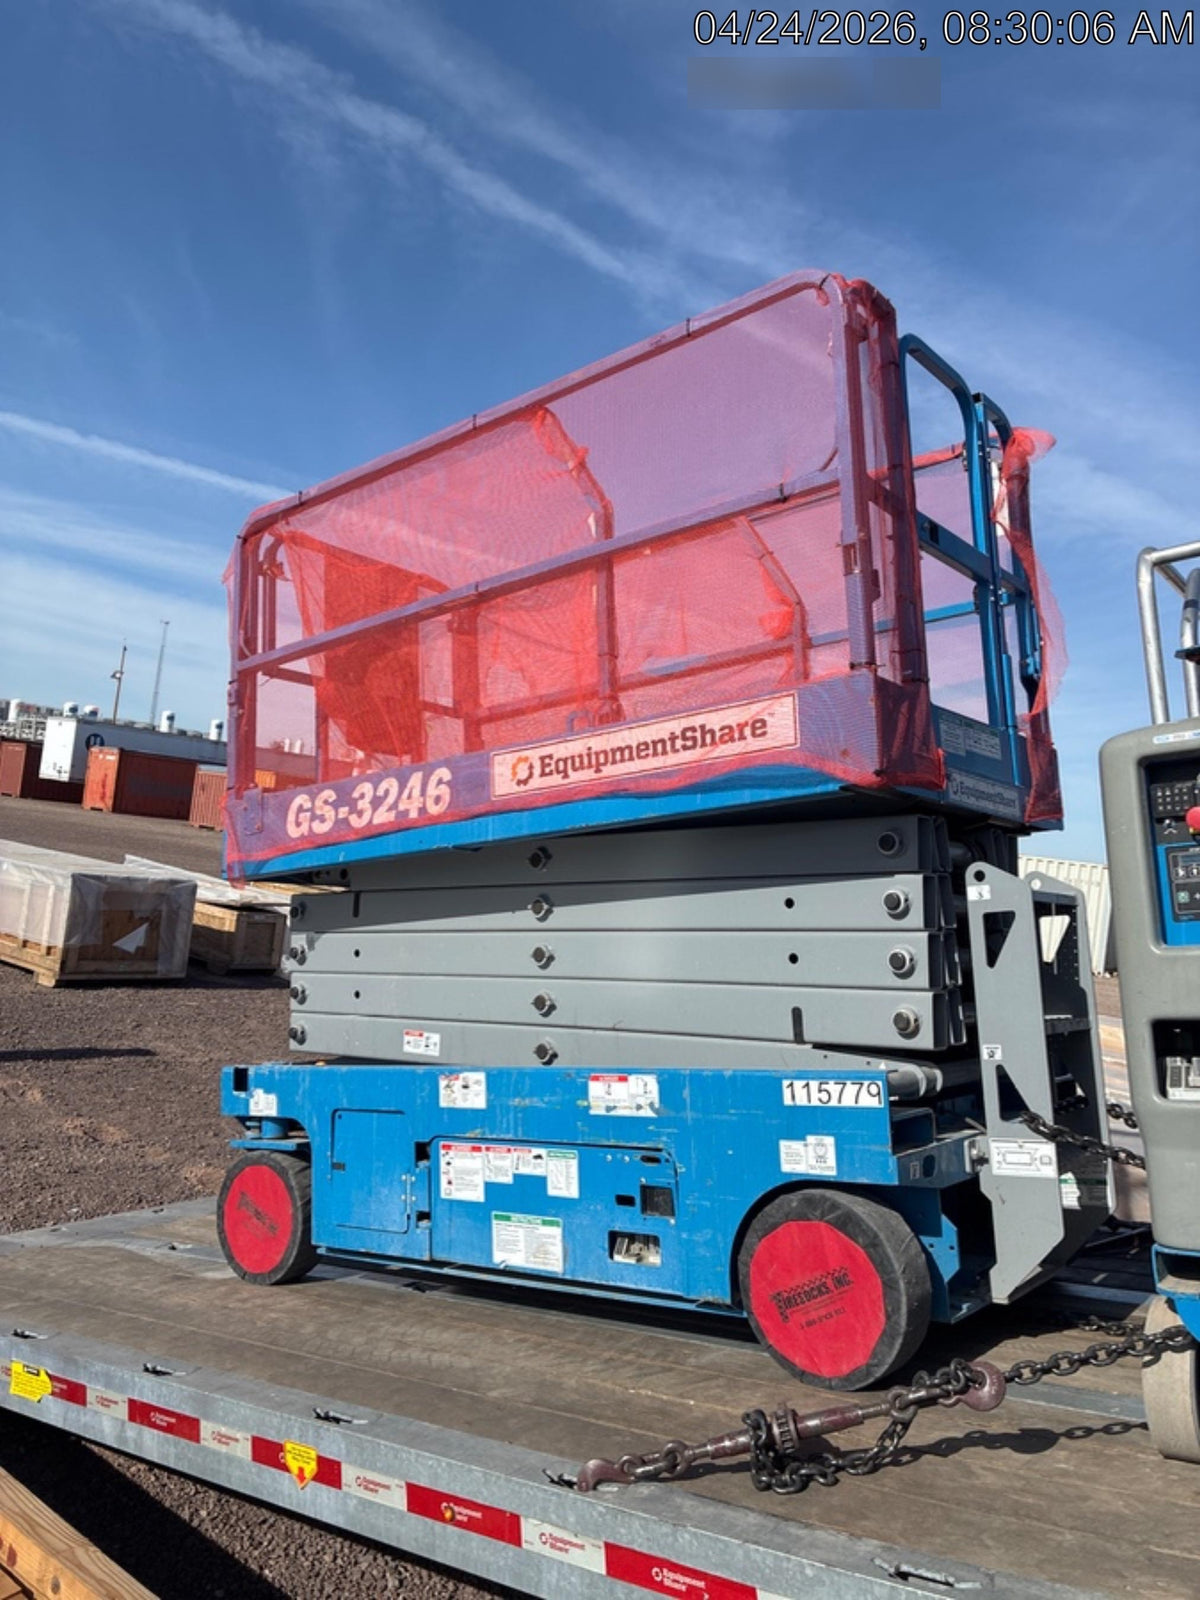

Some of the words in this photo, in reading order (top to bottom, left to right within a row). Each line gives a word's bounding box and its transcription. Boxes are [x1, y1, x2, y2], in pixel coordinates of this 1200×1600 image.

[539, 717, 767, 779] EquipmentShare
[286, 767, 452, 838] GS-3246
[786, 1081, 882, 1105] 115779
